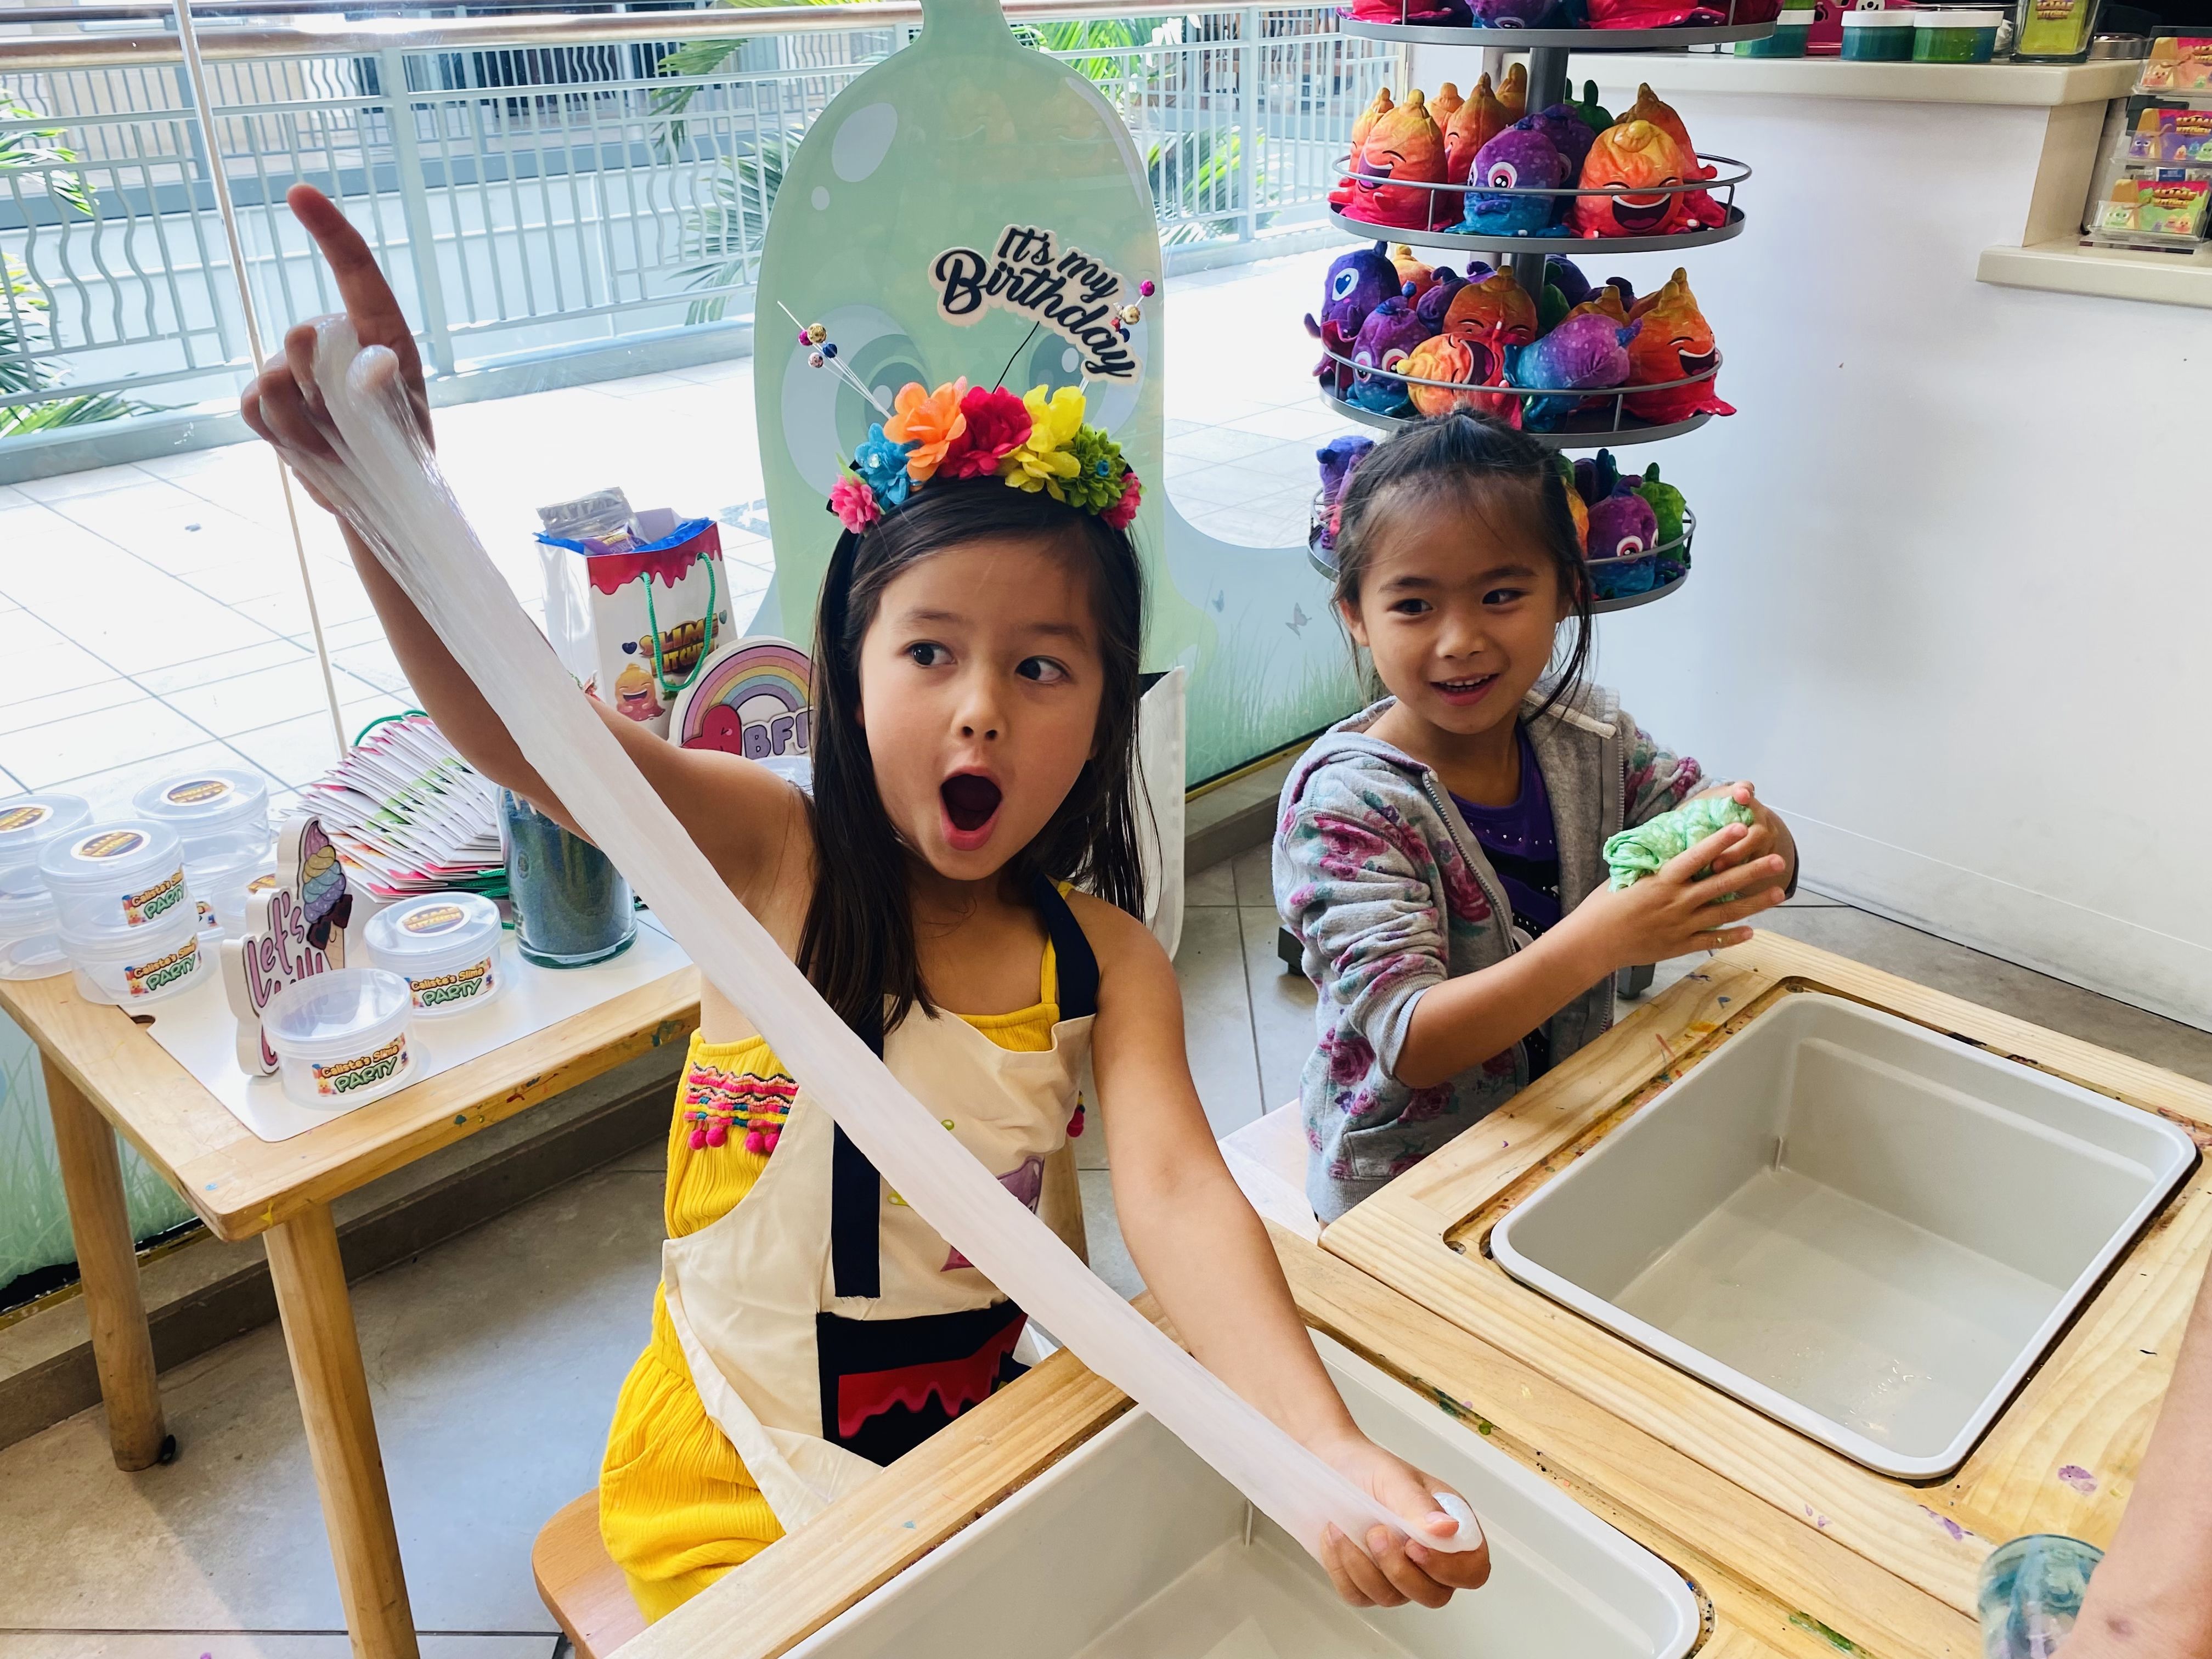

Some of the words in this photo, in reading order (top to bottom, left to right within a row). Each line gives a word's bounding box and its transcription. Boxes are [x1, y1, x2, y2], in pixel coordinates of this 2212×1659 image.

[997, 228, 1055, 262] It's
[1057, 251, 1119, 303] my
[935, 250, 1136, 377] Birthday
[144, 882, 184, 919] PARTY
[146, 953, 196, 991] PARTY
[458, 967, 484, 981] Slime
[422, 978, 482, 1007] PARTY
[373, 1045, 400, 1063] Slime
[334, 1056, 398, 1093] PARTY
